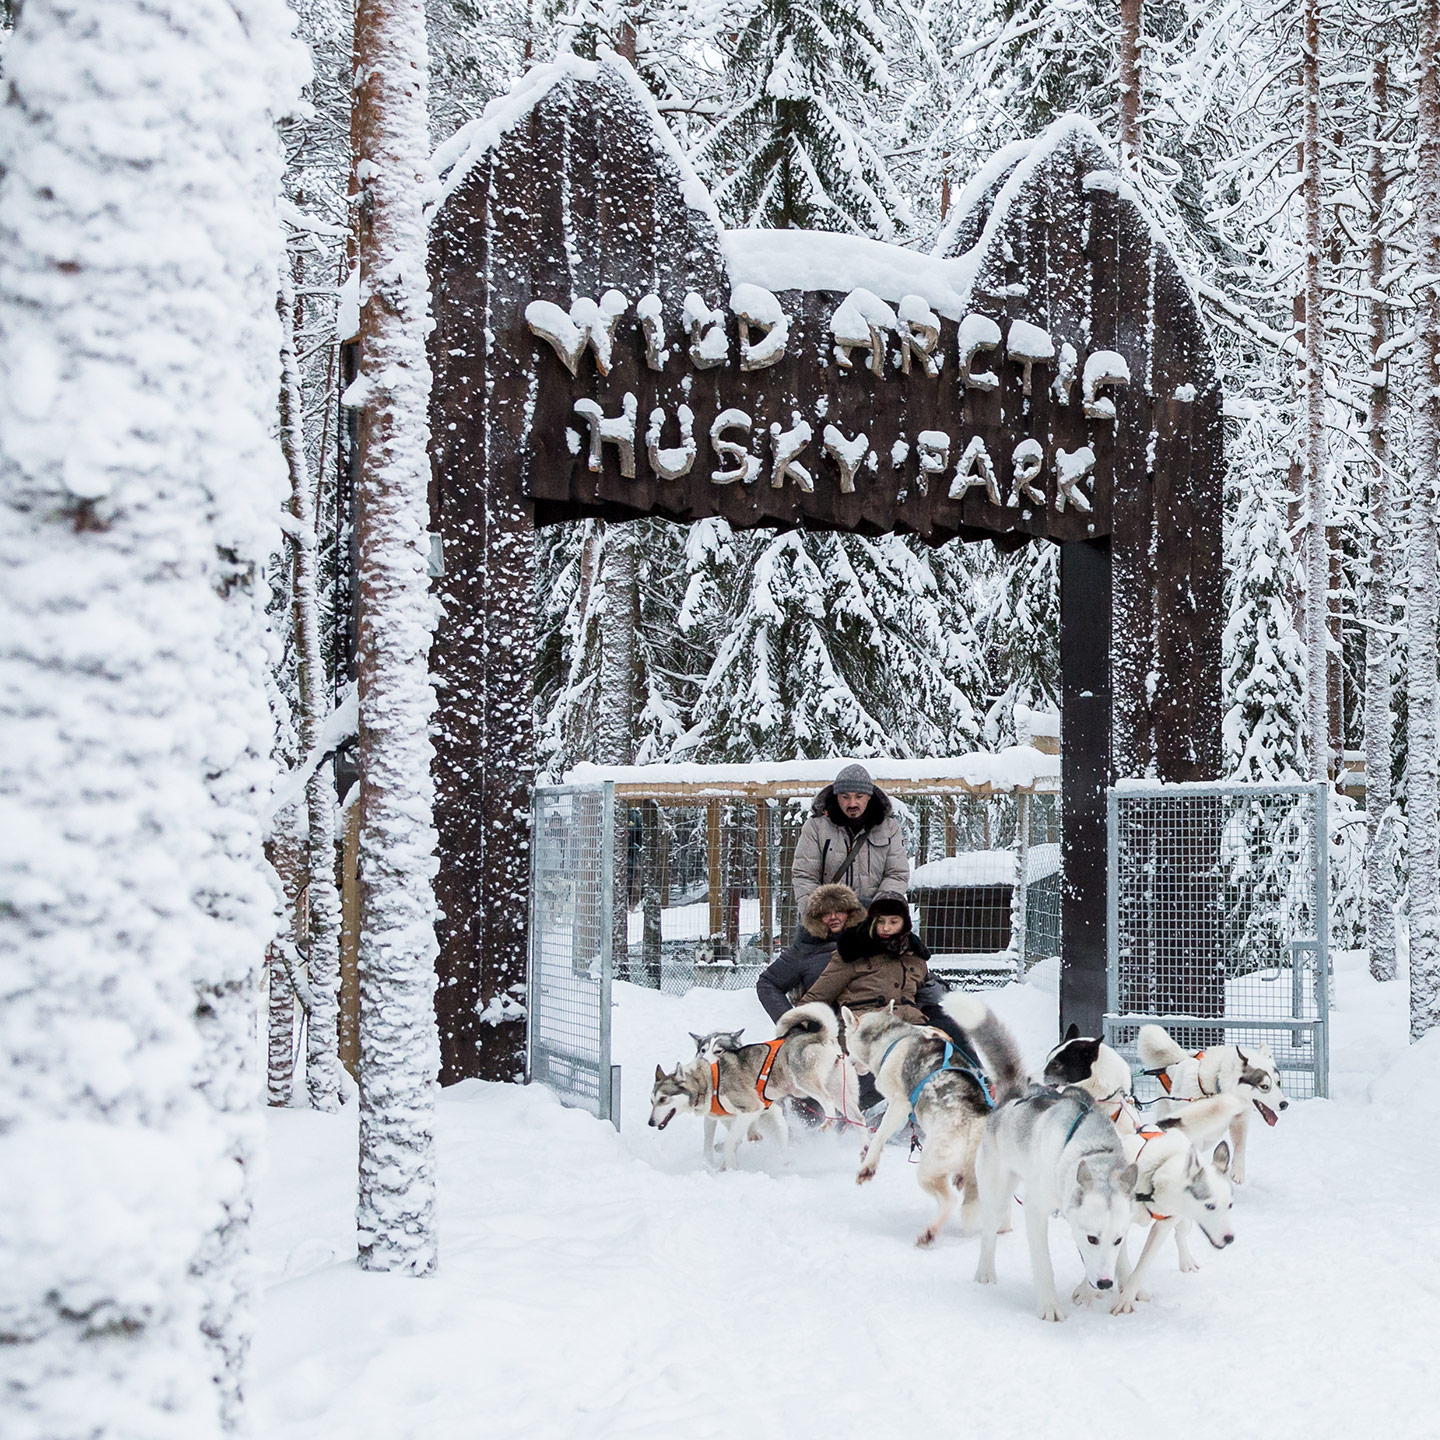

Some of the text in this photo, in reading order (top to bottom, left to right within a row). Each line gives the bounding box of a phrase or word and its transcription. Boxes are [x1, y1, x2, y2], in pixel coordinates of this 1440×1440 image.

[525, 284, 1129, 419] WILD ARCTIC
[573, 392, 1097, 513] HUSKY PARK
